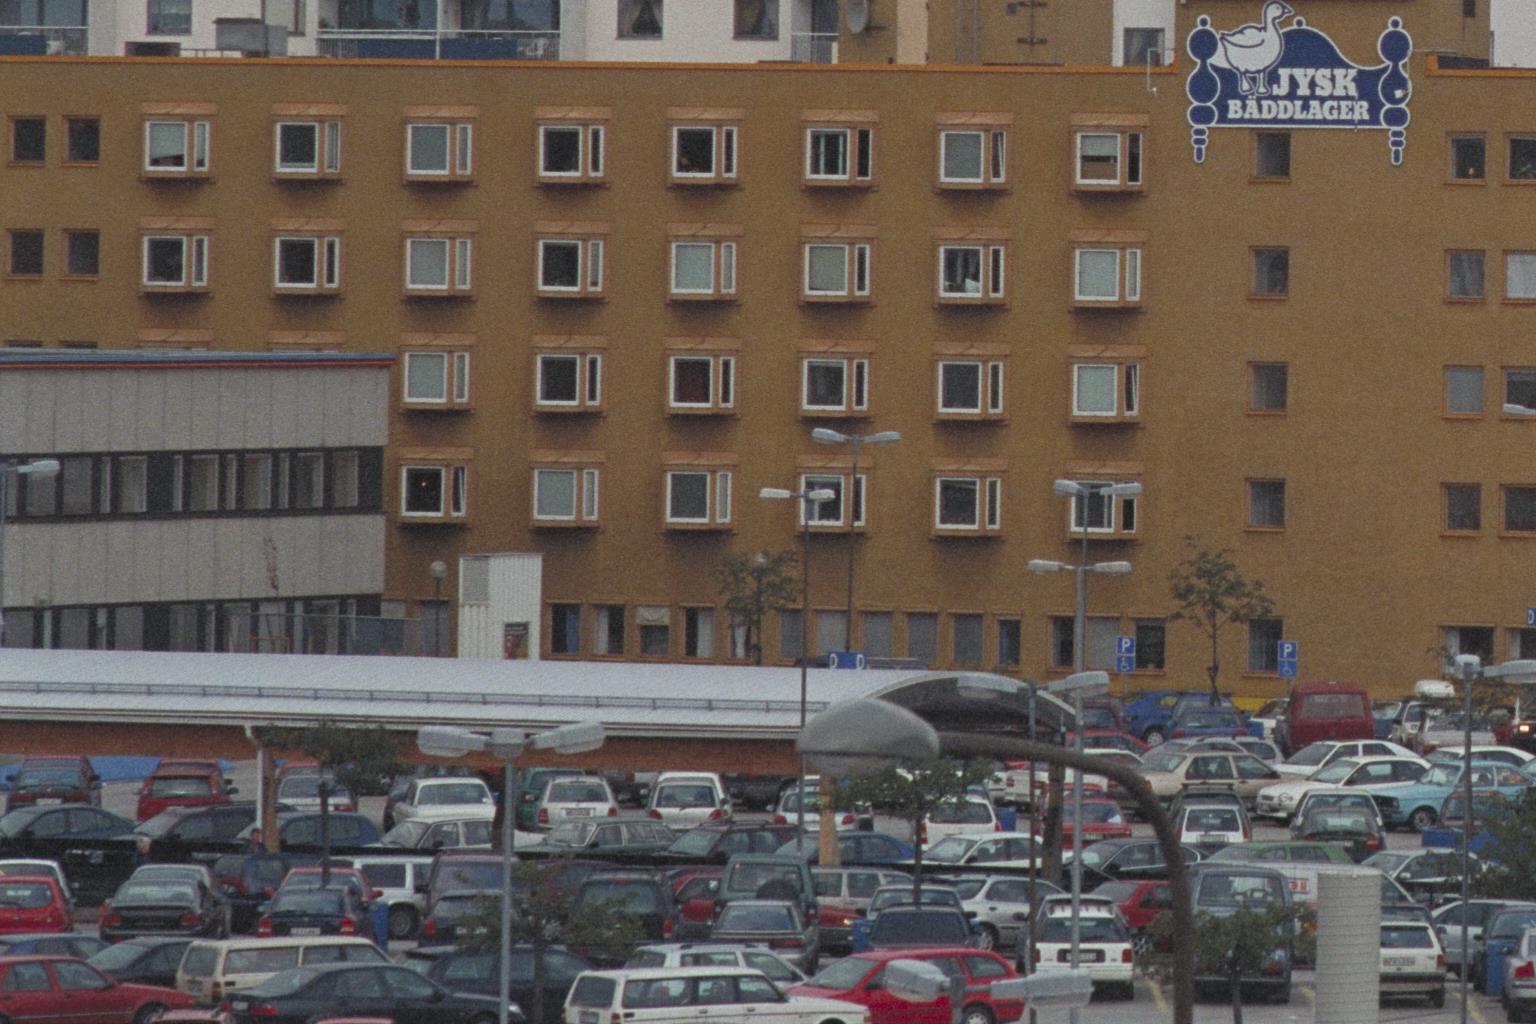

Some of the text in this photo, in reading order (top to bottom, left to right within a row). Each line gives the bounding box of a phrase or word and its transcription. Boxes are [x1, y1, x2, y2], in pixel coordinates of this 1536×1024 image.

[1272, 68, 1358, 97] JYSK
[1227, 95, 1370, 120] BÄDDLAGER
[1122, 638, 1131, 653] P
[1284, 644, 1292, 658] P
